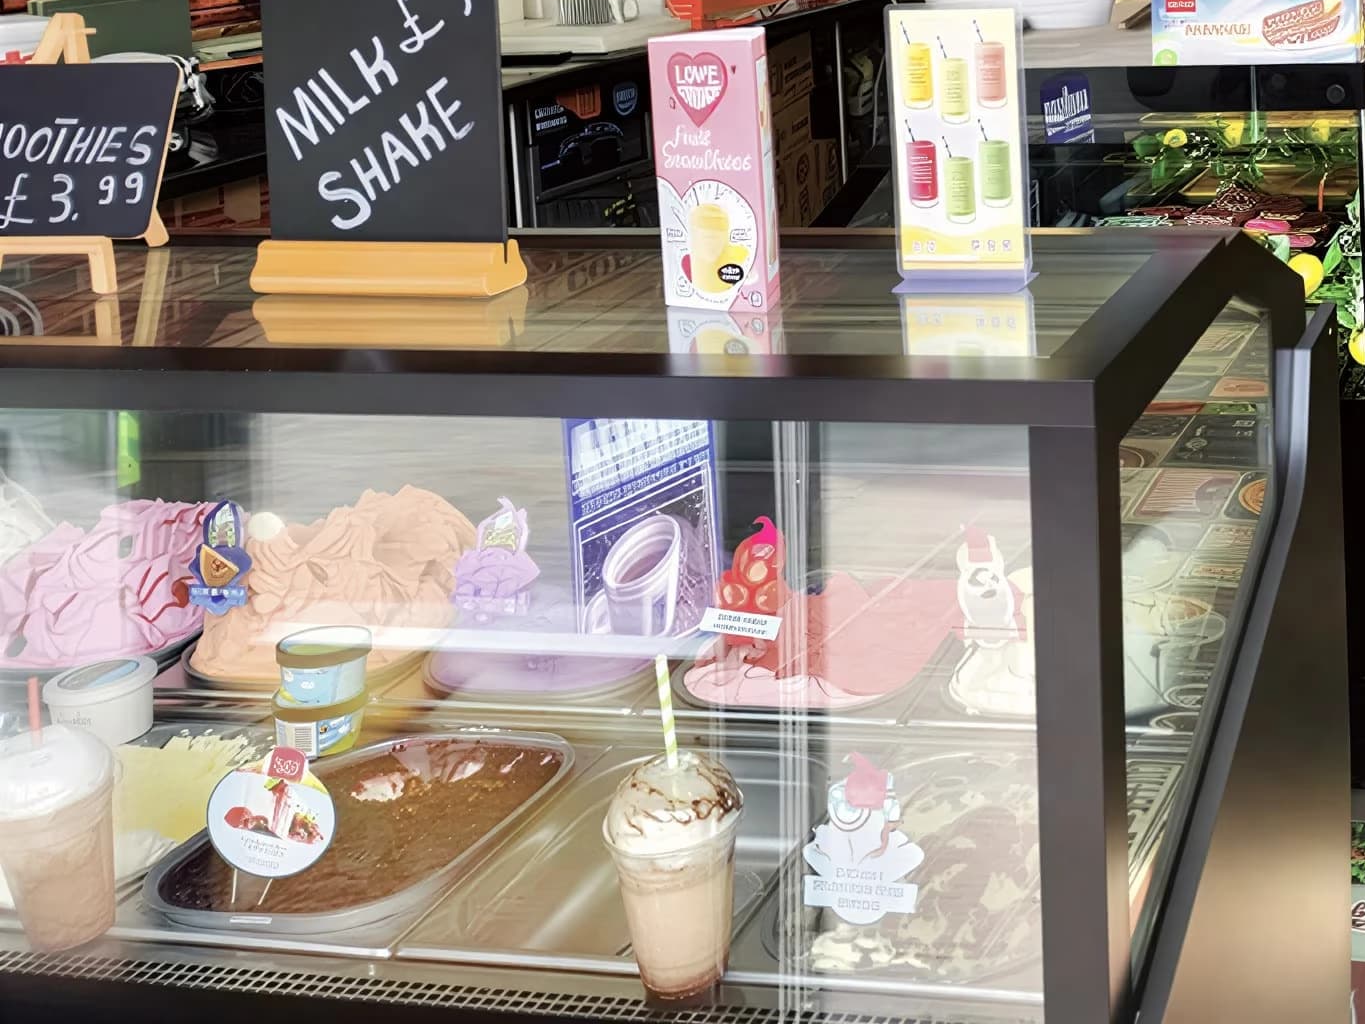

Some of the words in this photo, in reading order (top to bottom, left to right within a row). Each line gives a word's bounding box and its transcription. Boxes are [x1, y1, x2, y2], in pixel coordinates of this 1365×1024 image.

[0, 118, 158, 166] OOTHIES
[276, 36, 400, 161] MILK
[318, 76, 475, 230] SHAKE
